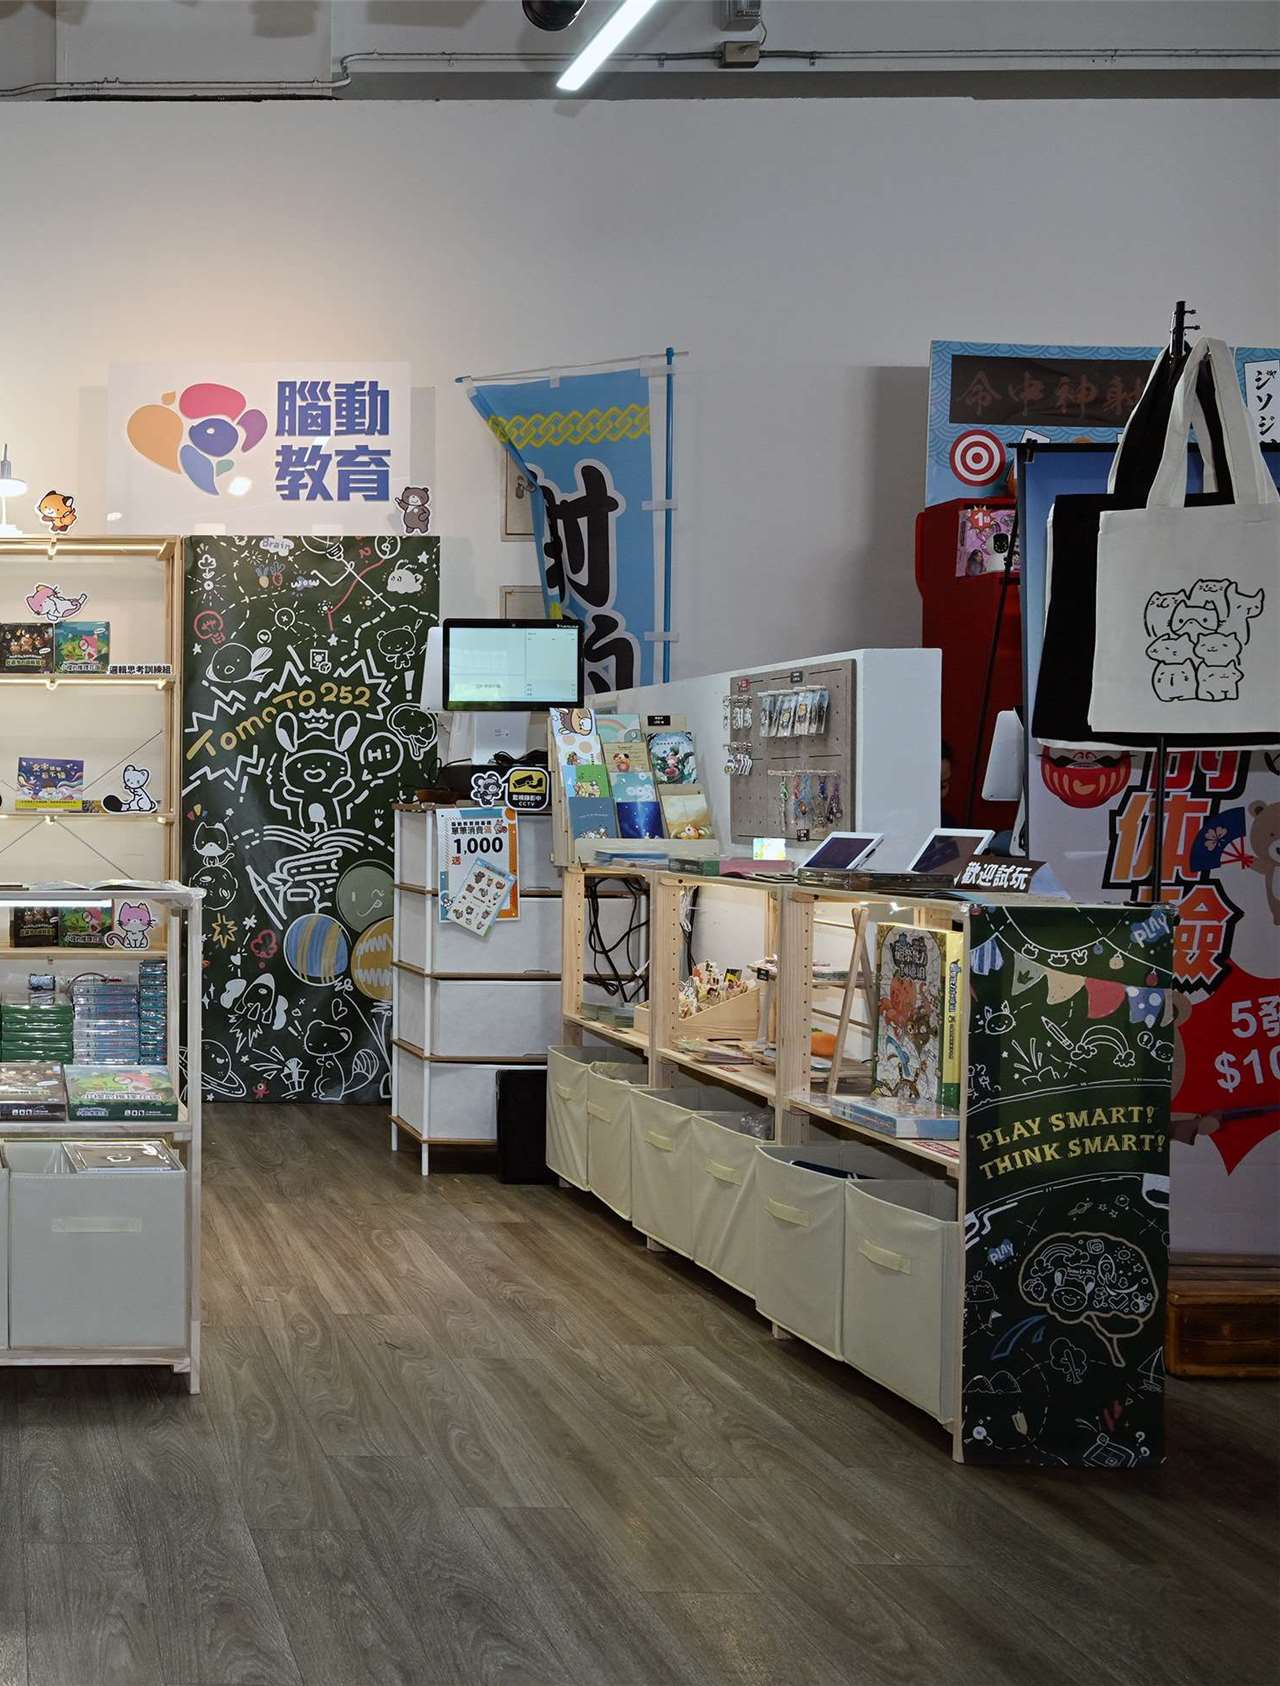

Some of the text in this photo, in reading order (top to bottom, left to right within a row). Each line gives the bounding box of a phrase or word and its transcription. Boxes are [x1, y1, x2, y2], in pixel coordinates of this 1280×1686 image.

[275, 380, 390, 437] 腦動
[274, 444, 391, 502] 教育
[453, 837, 503, 855] 1,000
[960, 861, 1033, 890] 歡迎試玩
[1133, 911, 1171, 948] PLAY
[976, 1105, 1156, 1152] PLAY SMART!
[978, 1133, 1167, 1181] THINK SMART!
